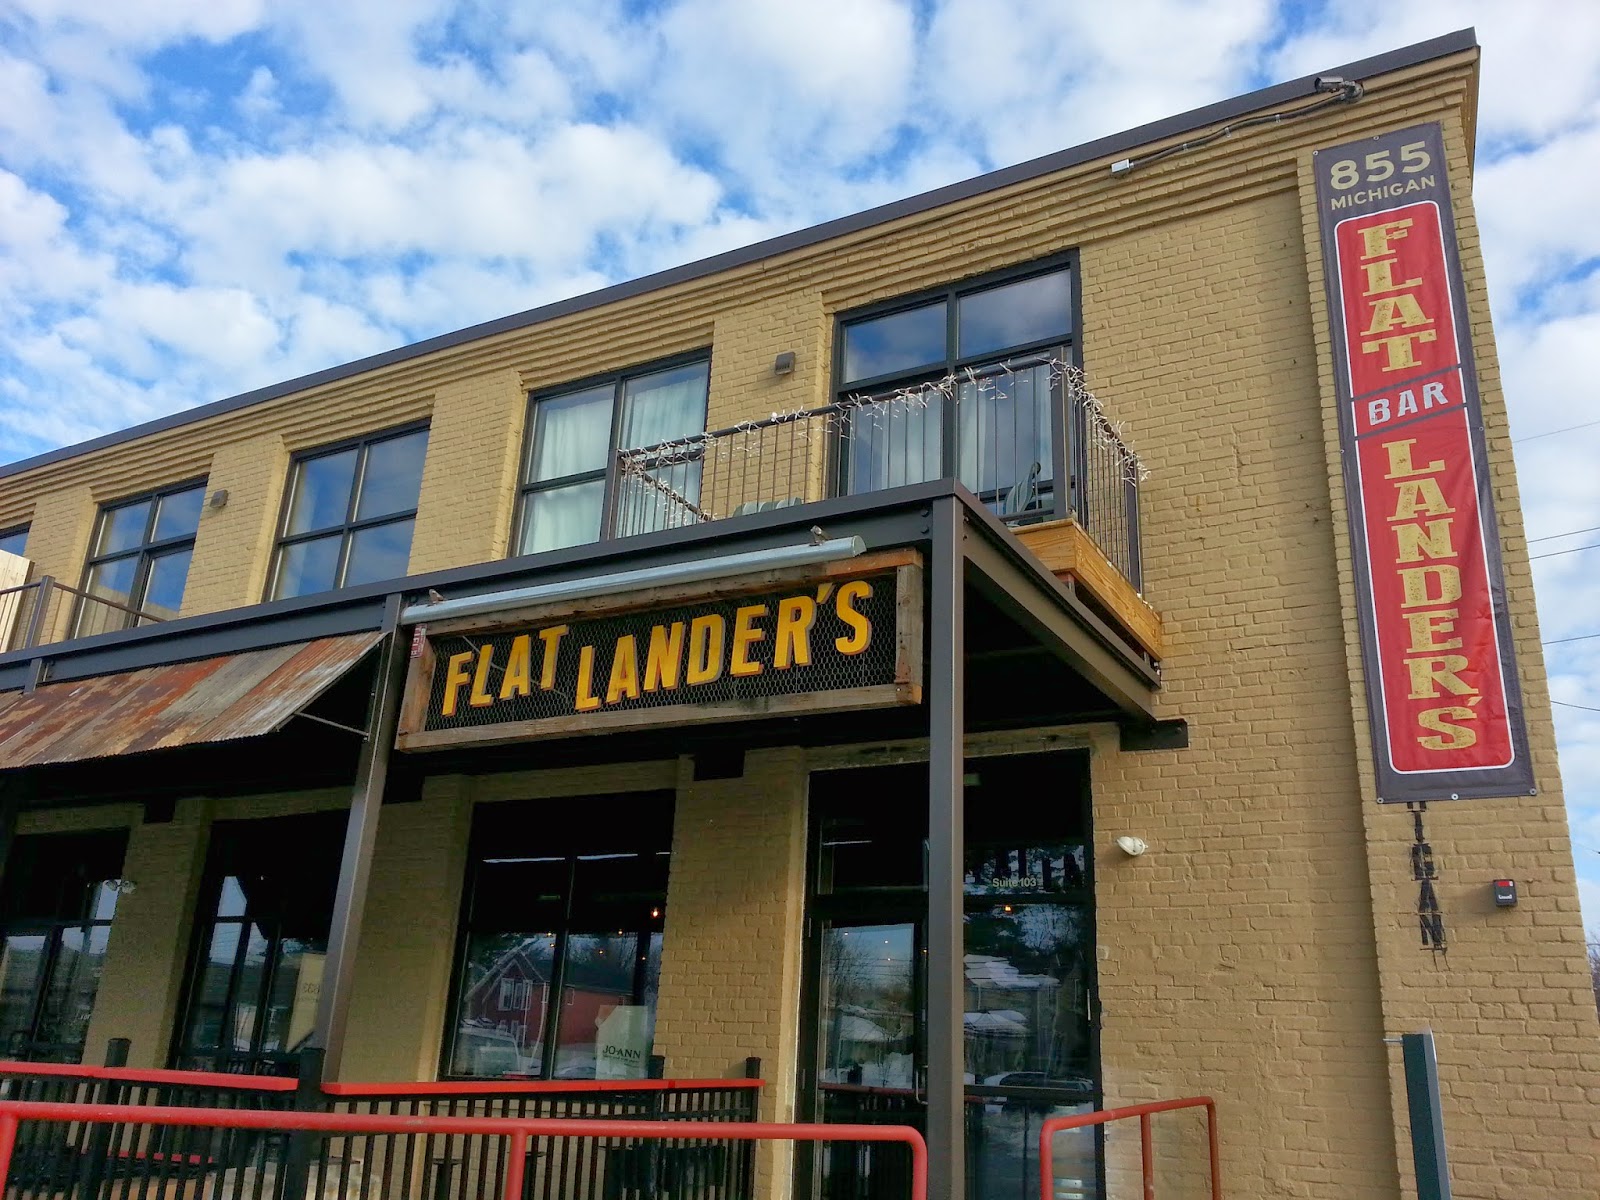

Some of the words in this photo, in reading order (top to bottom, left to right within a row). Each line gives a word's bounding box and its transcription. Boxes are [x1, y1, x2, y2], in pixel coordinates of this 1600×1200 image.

[1330, 141, 1431, 191] 855
[1331, 175, 1435, 210] MICHIGAN
[1357, 218, 1438, 373] FLAT
[1368, 382, 1448, 425] BAR
[442, 624, 568, 717] FLAT
[574, 580, 873, 712] LANDER'S
[992, 877, 1018, 888] Suite
[1020, 877, 1037, 887] 103
